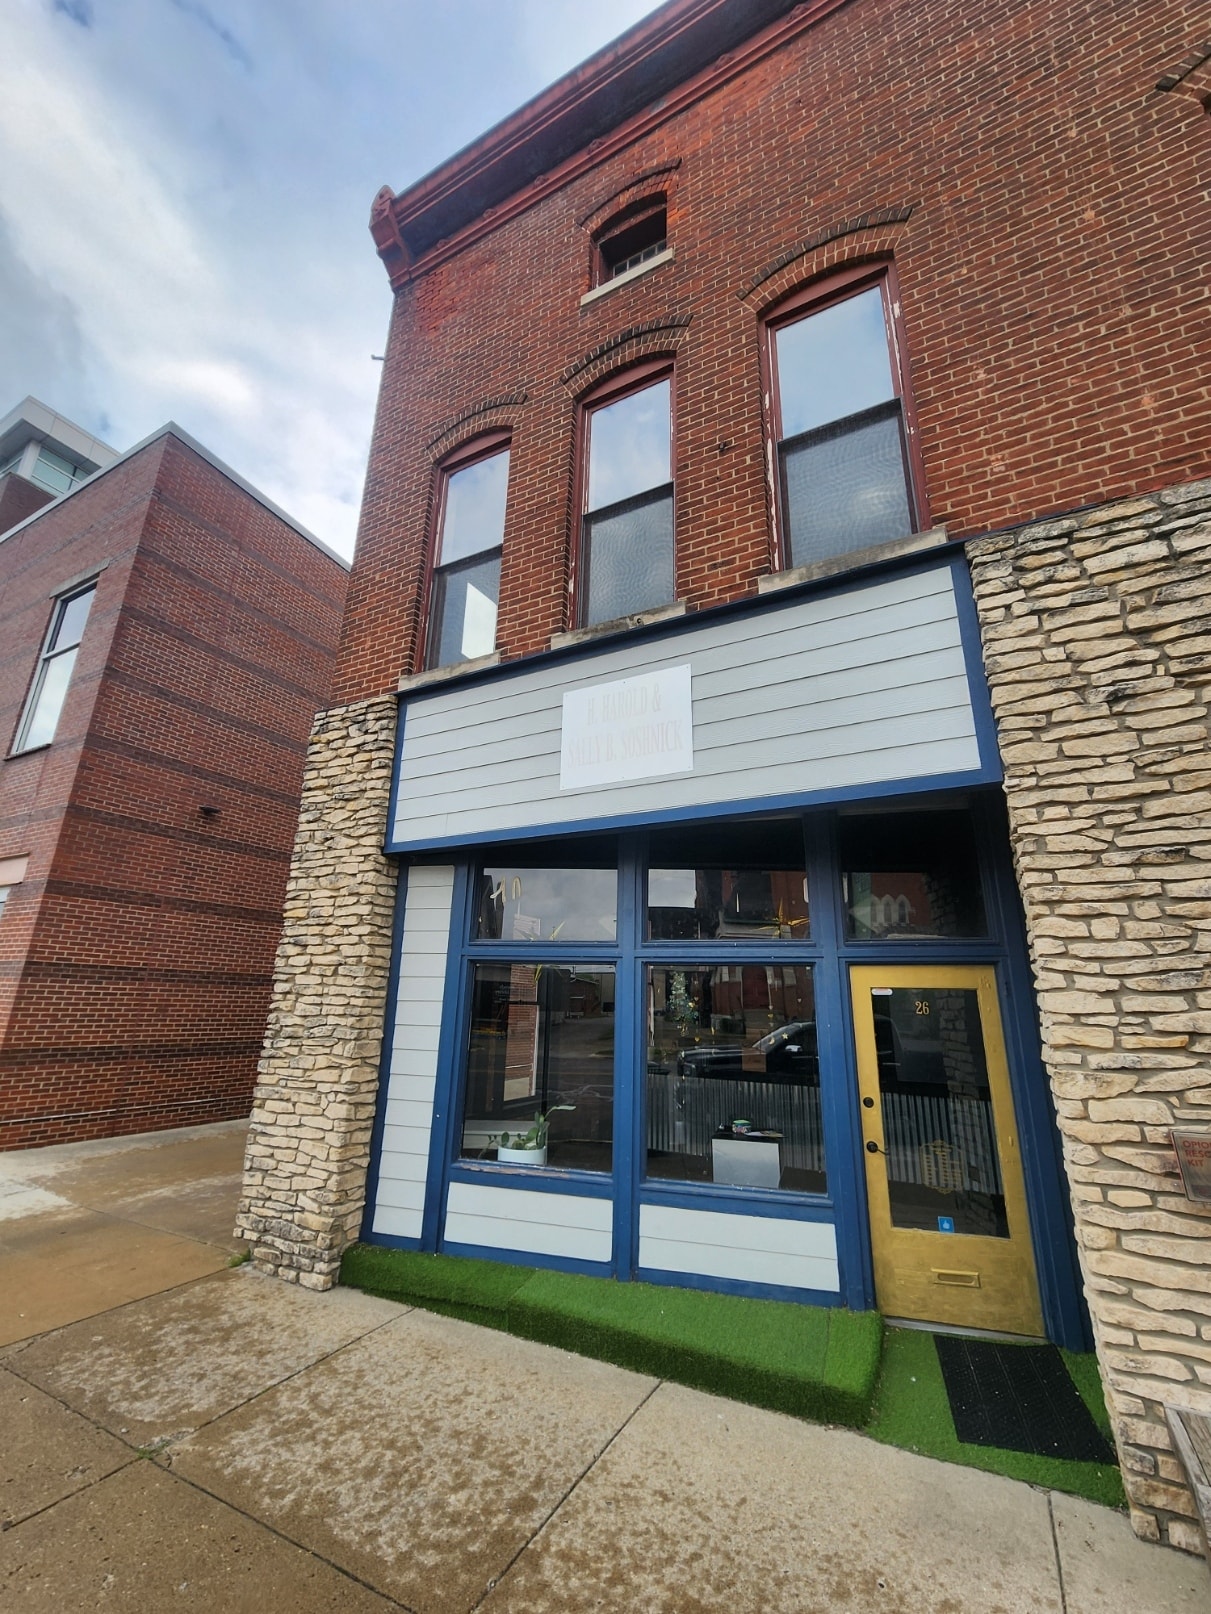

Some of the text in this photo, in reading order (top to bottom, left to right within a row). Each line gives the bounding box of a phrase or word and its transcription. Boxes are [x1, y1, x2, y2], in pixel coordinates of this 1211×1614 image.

[602, 686, 648, 722] HAROLD
[652, 682, 662, 712] &
[569, 735, 600, 768] SALLY
[620, 720, 683, 760] SOSHNICK
[915, 1001, 930, 1015] 26
[1188, 1159, 1203, 1167] KIT
